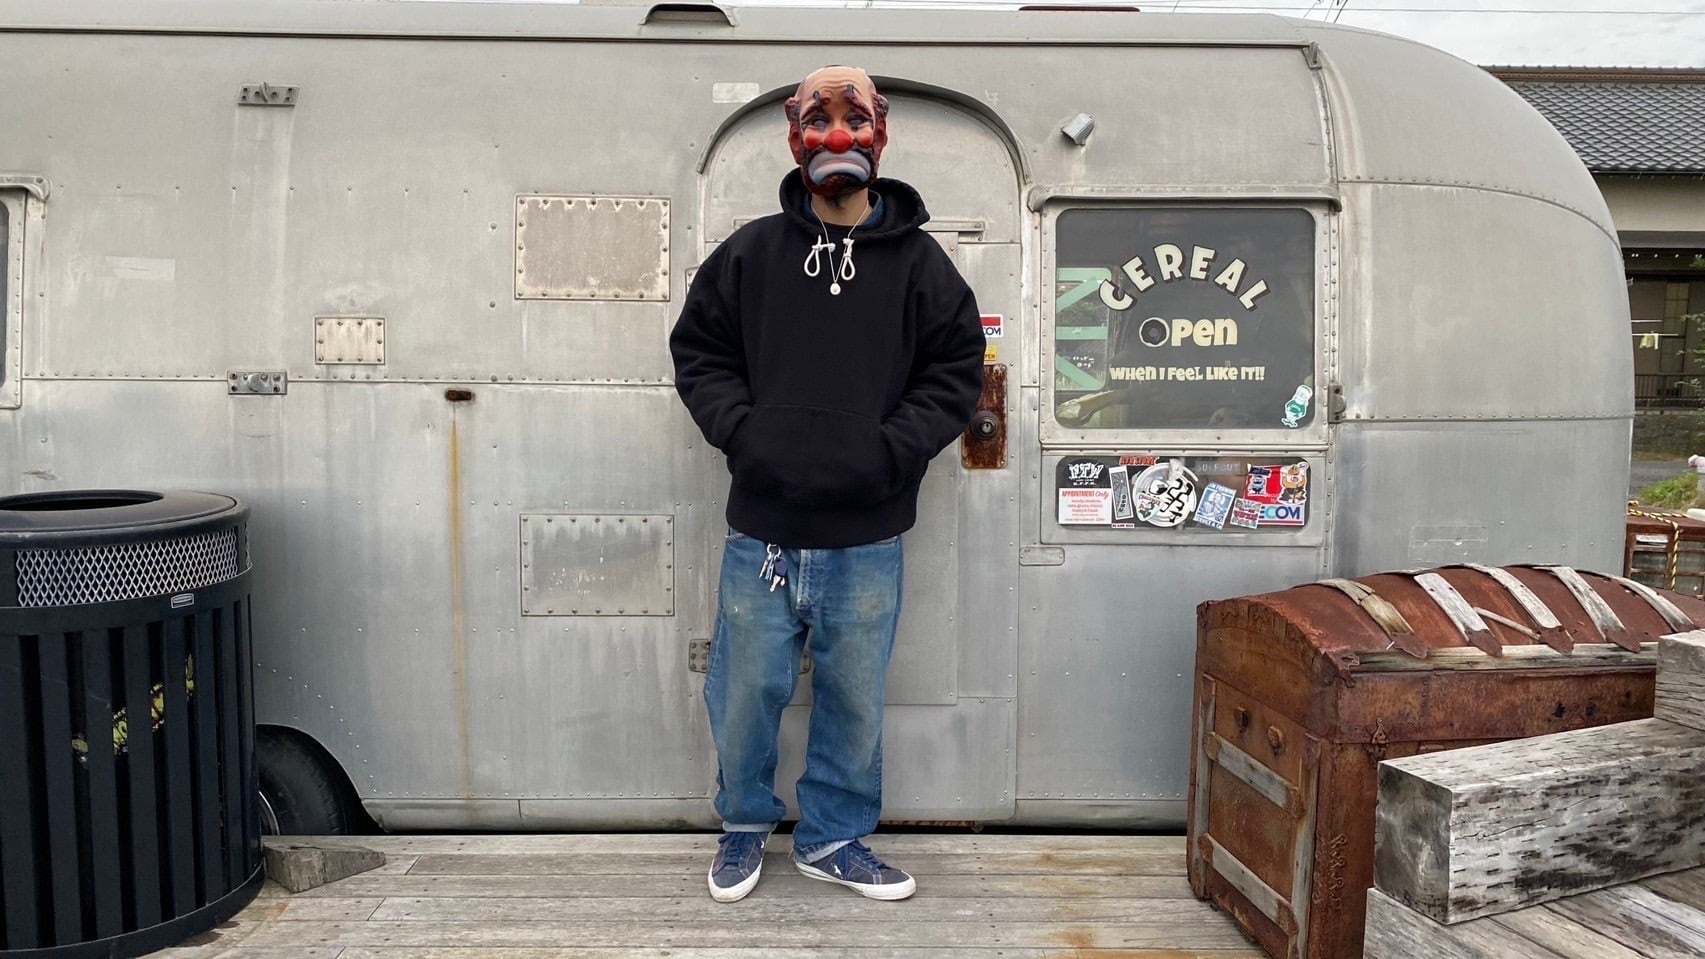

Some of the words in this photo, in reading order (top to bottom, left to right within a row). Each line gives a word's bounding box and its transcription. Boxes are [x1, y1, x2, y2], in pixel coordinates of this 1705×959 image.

[1099, 243, 1269, 311] CEREAL
[1159, 367, 1166, 381] I
[1259, 505, 1301, 520] ECOM
